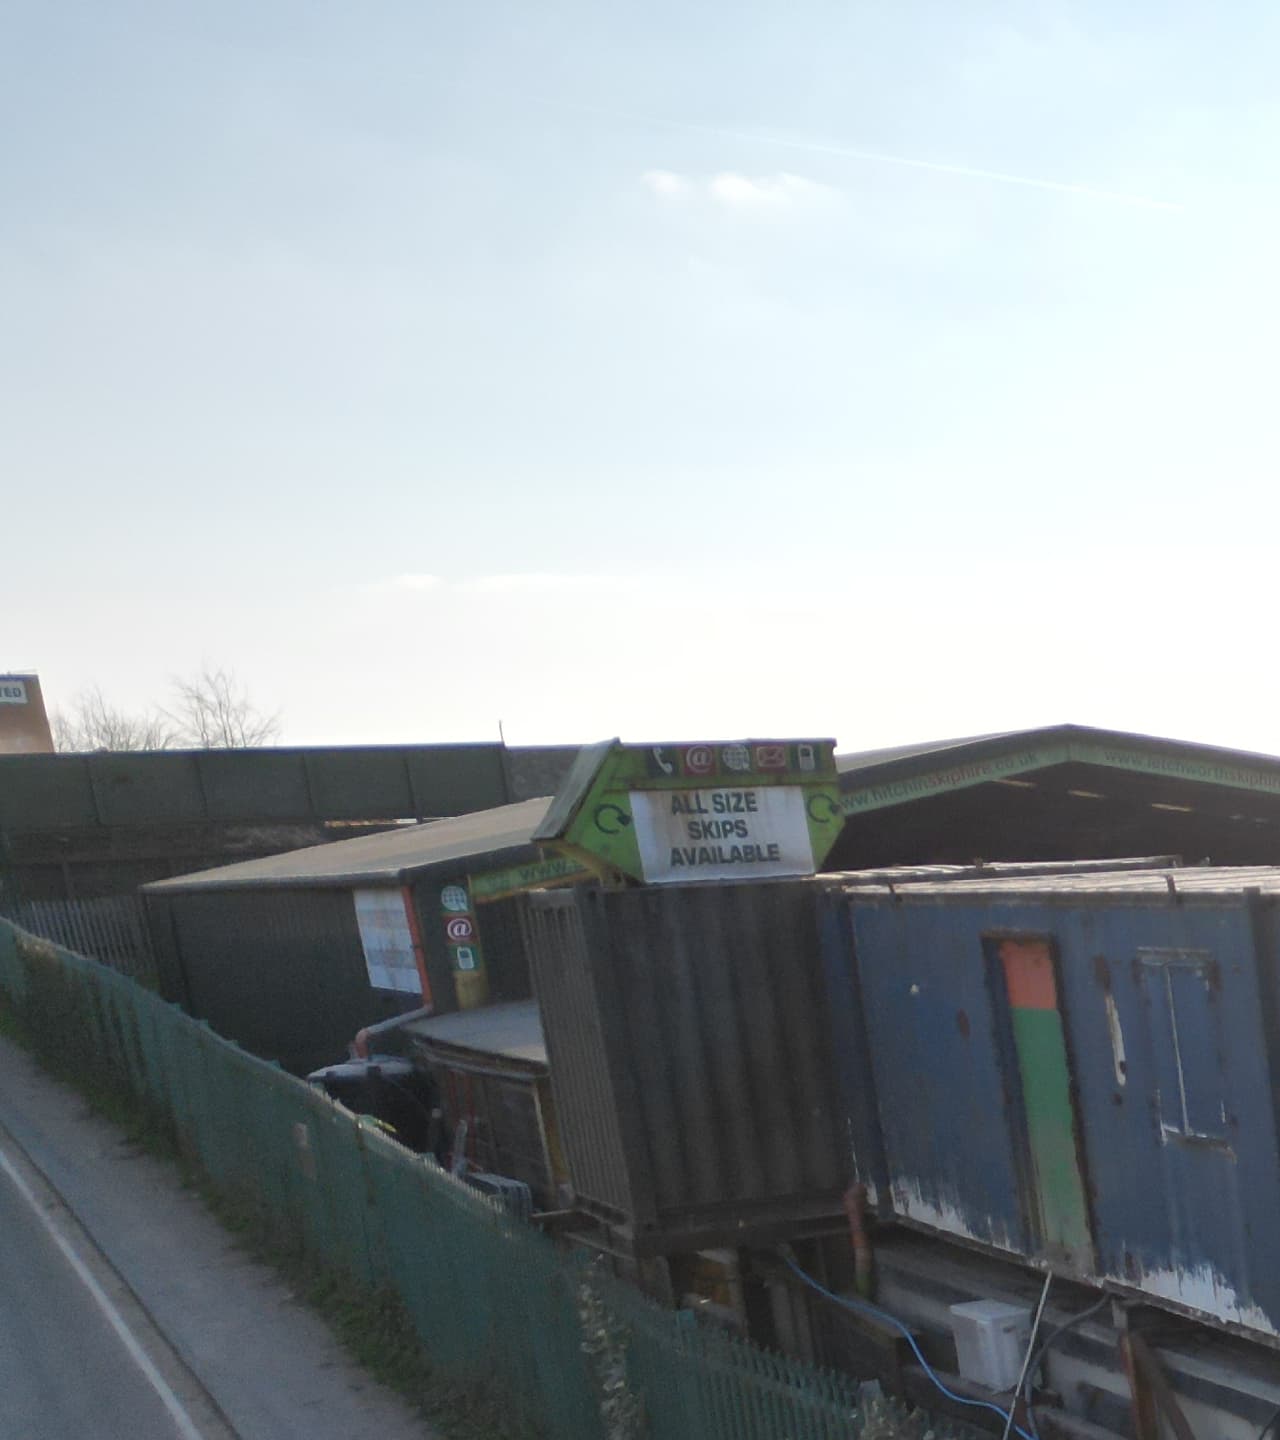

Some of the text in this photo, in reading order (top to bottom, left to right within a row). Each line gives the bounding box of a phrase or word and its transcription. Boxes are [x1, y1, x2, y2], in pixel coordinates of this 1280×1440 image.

[840, 752, 1038, 810] ww.hitchinskiphire.co.uk
[671, 792, 758, 815] ALL SIZE
[688, 819, 748, 840] SKIPS
[670, 843, 781, 867] AVAILABLE
